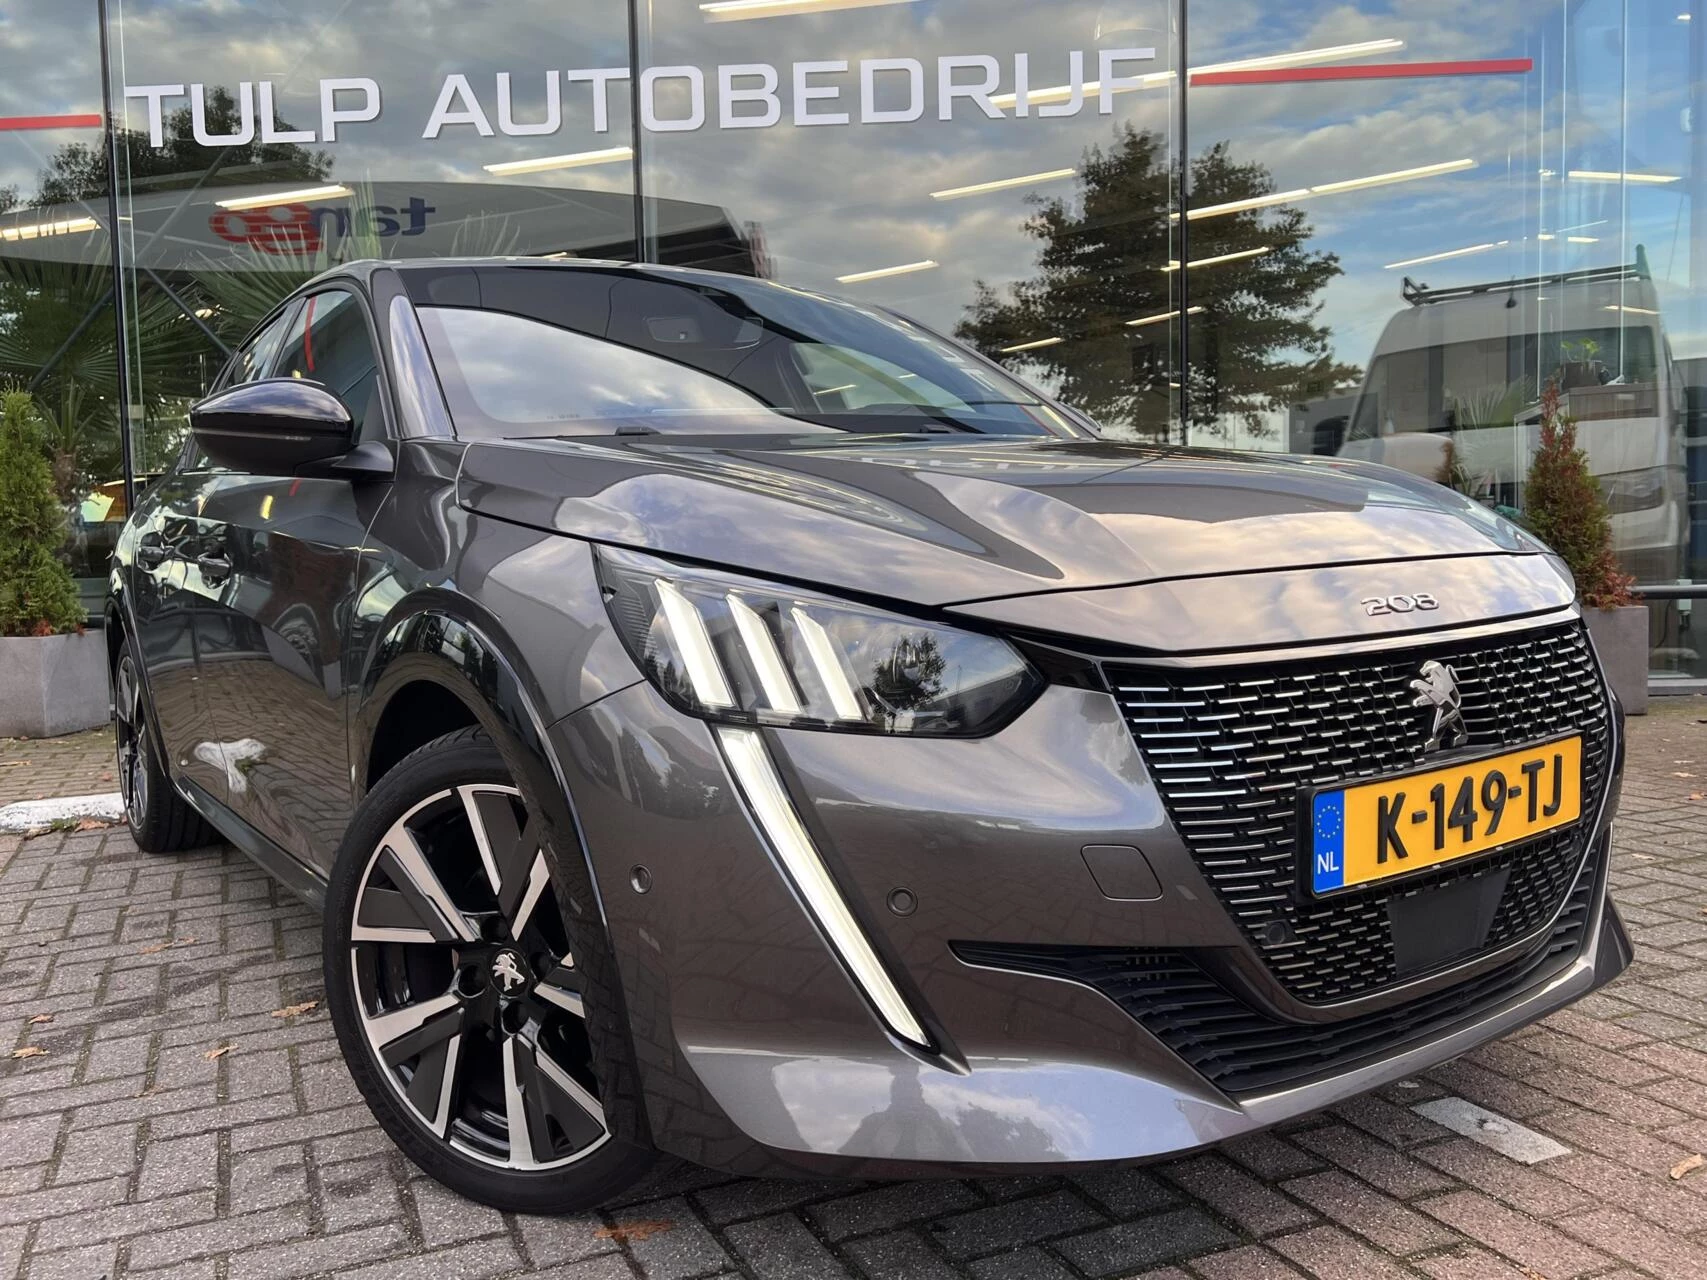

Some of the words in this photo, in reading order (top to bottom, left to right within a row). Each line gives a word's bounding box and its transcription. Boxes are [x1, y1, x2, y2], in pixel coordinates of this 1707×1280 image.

[124, 77, 381, 149] TULP
[421, 47, 1156, 139] AUTOBEDRIJF
[1360, 592, 1440, 617] 208
[1377, 753, 1563, 865] K-149-TJ
[1317, 850, 1340, 875] NL
